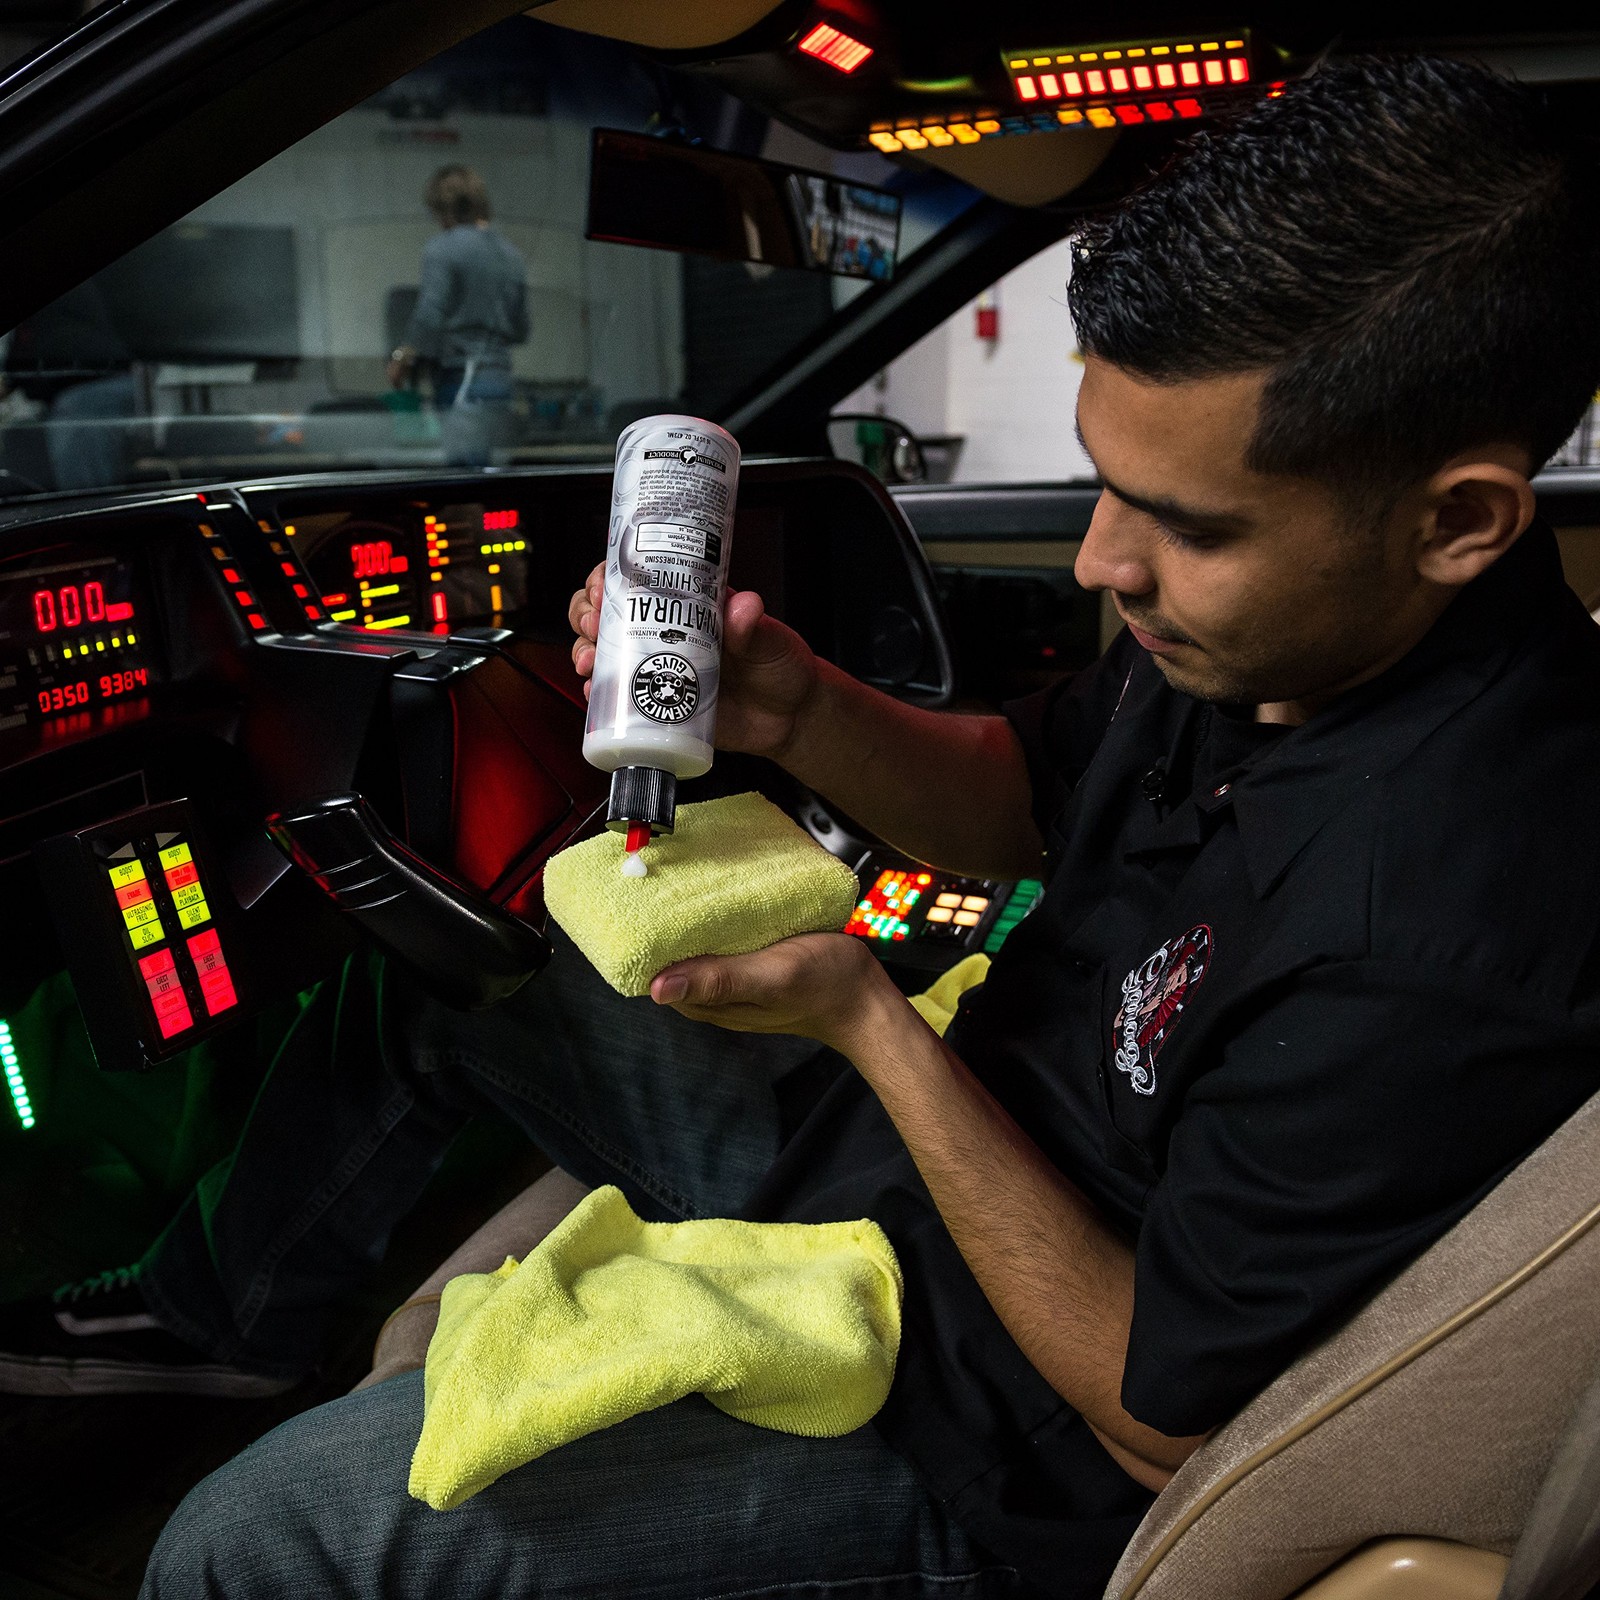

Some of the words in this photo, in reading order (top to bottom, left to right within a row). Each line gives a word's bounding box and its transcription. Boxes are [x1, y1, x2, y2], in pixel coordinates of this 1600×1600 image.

[697, 456, 723, 469] PREMIUM
[692, 516, 706, 526] Shine
[668, 534, 686, 542] System
[686, 536, 704, 546] Coating
[670, 543, 694, 552] Blockers
[644, 556, 676, 564] DRESSING
[676, 560, 711, 574] PROTECTANT
[650, 570, 701, 594] SHINE
[34, 581, 106, 632] 000
[628, 597, 716, 636] NATURAL
[688, 636, 712, 649] RESTORES
[652, 656, 687, 674] GUYS
[38, 681, 89, 713] 0350
[99, 668, 148, 697] 9384
[636, 686, 696, 720] CHEMICAL
[168, 848, 182, 858] BOOST
[119, 865, 134, 877] BOOST
[180, 894, 200, 906] PLAYBACK
[126, 903, 153, 919] ULTRASONIC
[186, 906, 201, 917] SILENT
[190, 914, 202, 923] MODE
[142, 928, 150, 936] OIL
[142, 934, 155, 943] SLICK
[203, 953, 215, 964] EJECT
[206, 961, 216, 971] LEFT
[156, 974, 168, 984] EJECT
[160, 982, 171, 993] LEFT
